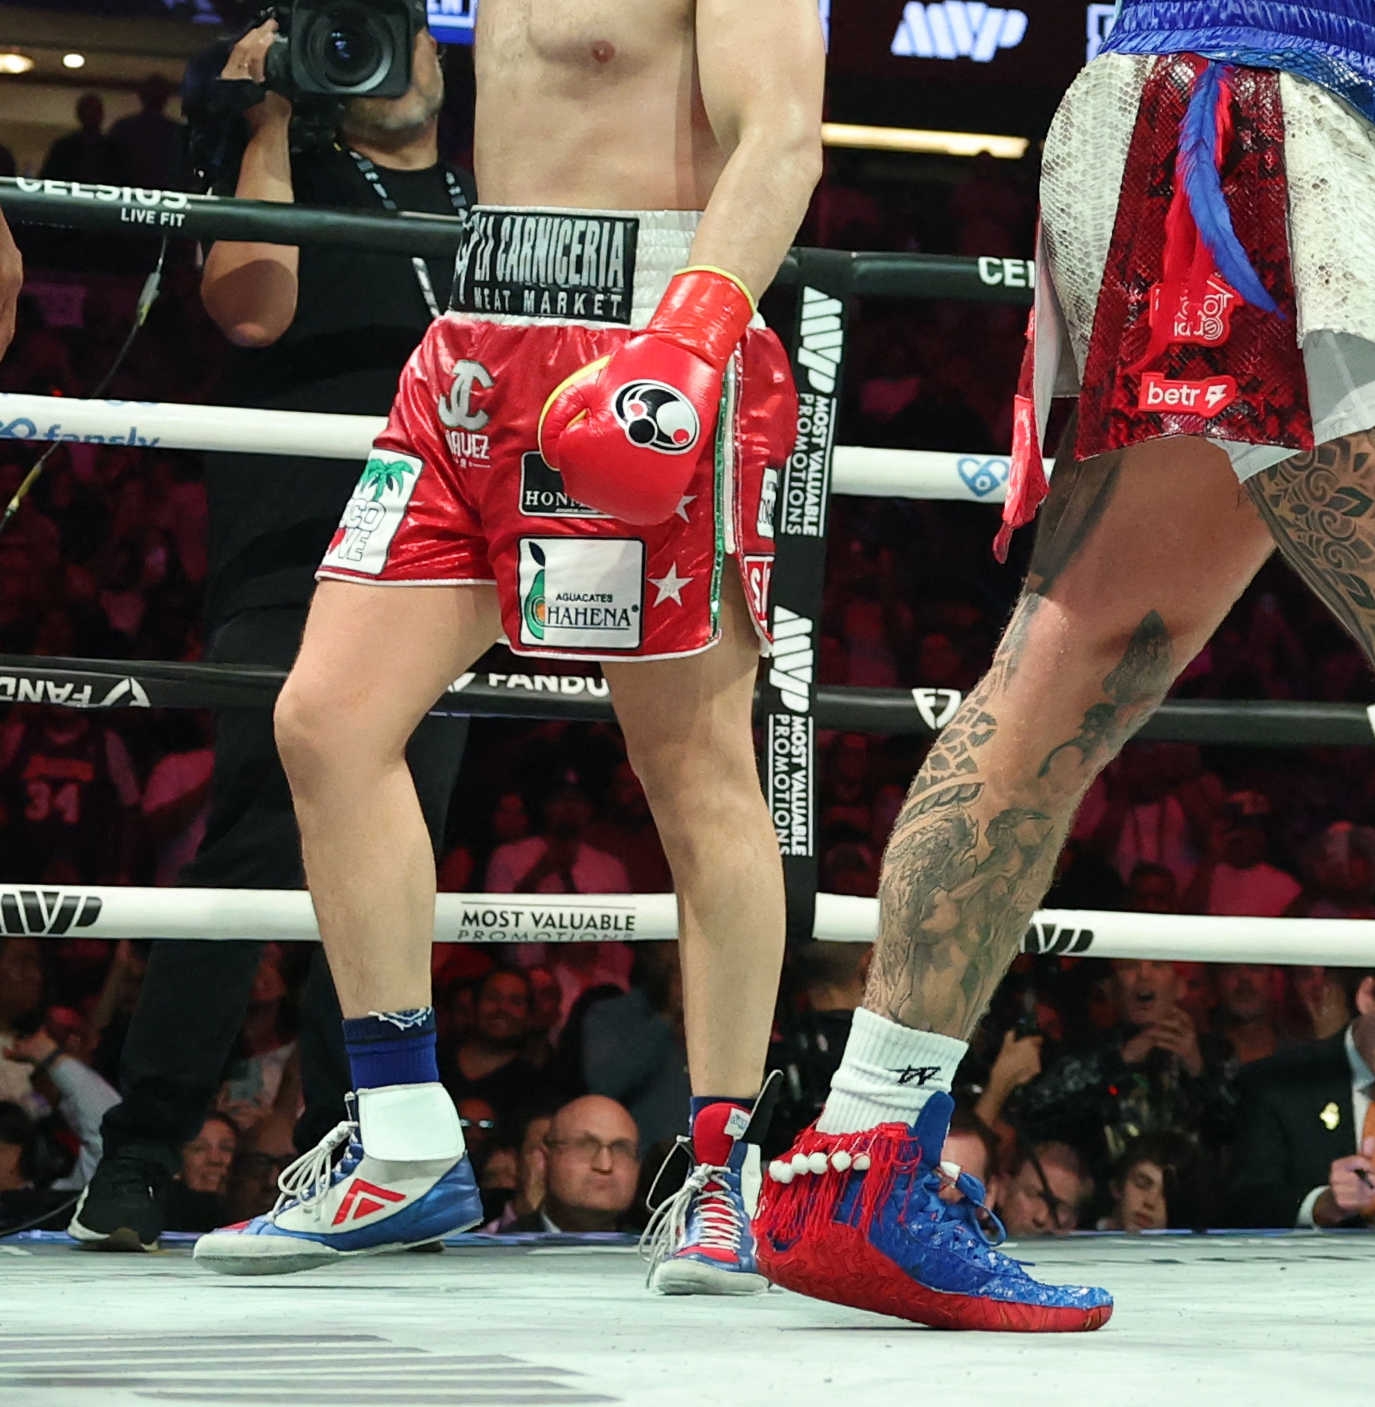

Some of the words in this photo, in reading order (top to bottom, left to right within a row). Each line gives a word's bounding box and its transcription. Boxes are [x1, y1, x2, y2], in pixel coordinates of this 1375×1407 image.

[121, 207, 157, 225] LIVE
[160, 211, 185, 227] FIT
[474, 215, 495, 281] LA
[496, 216, 625, 289] CARNICERIA
[474, 287, 511, 311] MEAT
[523, 289, 622, 316] MARKET
[1147, 381, 1201, 406] betr
[811, 395, 830, 447] MOST
[786, 393, 815, 535] PROMOTIONS
[802, 451, 826, 537] VALUABLE
[556, 592, 613, 604] AGUACATES
[488, 672, 610, 697] FANDU
[791, 716, 808, 766] MOST
[773, 714, 792, 856] PROMOTIONS
[790, 769, 808, 857] VALUABLE
[461, 910, 524, 929] MOST
[531, 911, 636, 932] VALUABLE
